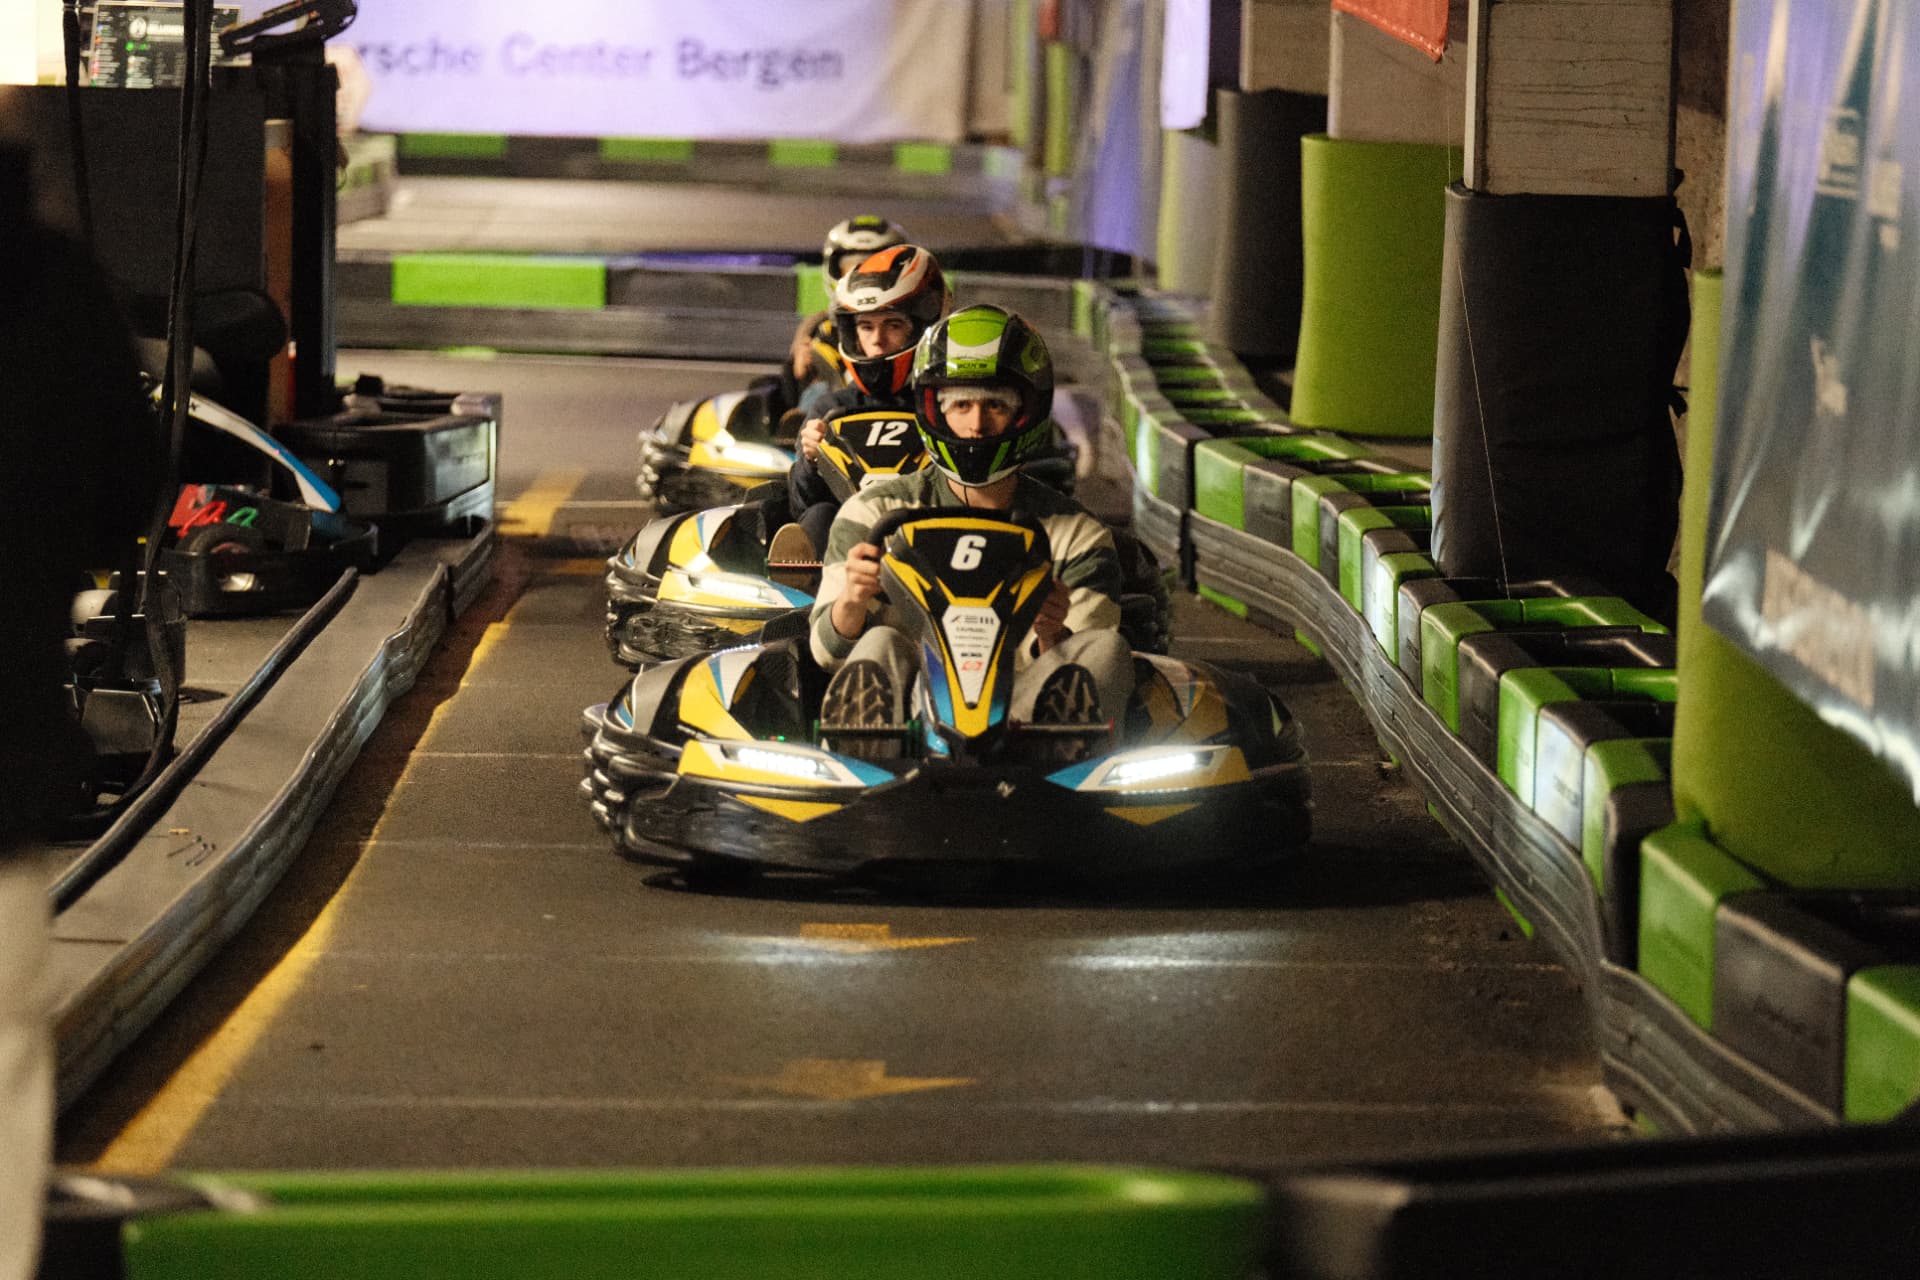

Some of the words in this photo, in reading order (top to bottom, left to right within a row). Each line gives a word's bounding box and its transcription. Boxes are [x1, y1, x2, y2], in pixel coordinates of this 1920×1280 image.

[356, 36, 482, 76] rsche
[502, 34, 652, 77] Center
[677, 38, 843, 88] Bergen
[866, 421, 909, 446] 12
[950, 534, 987, 570] 6
